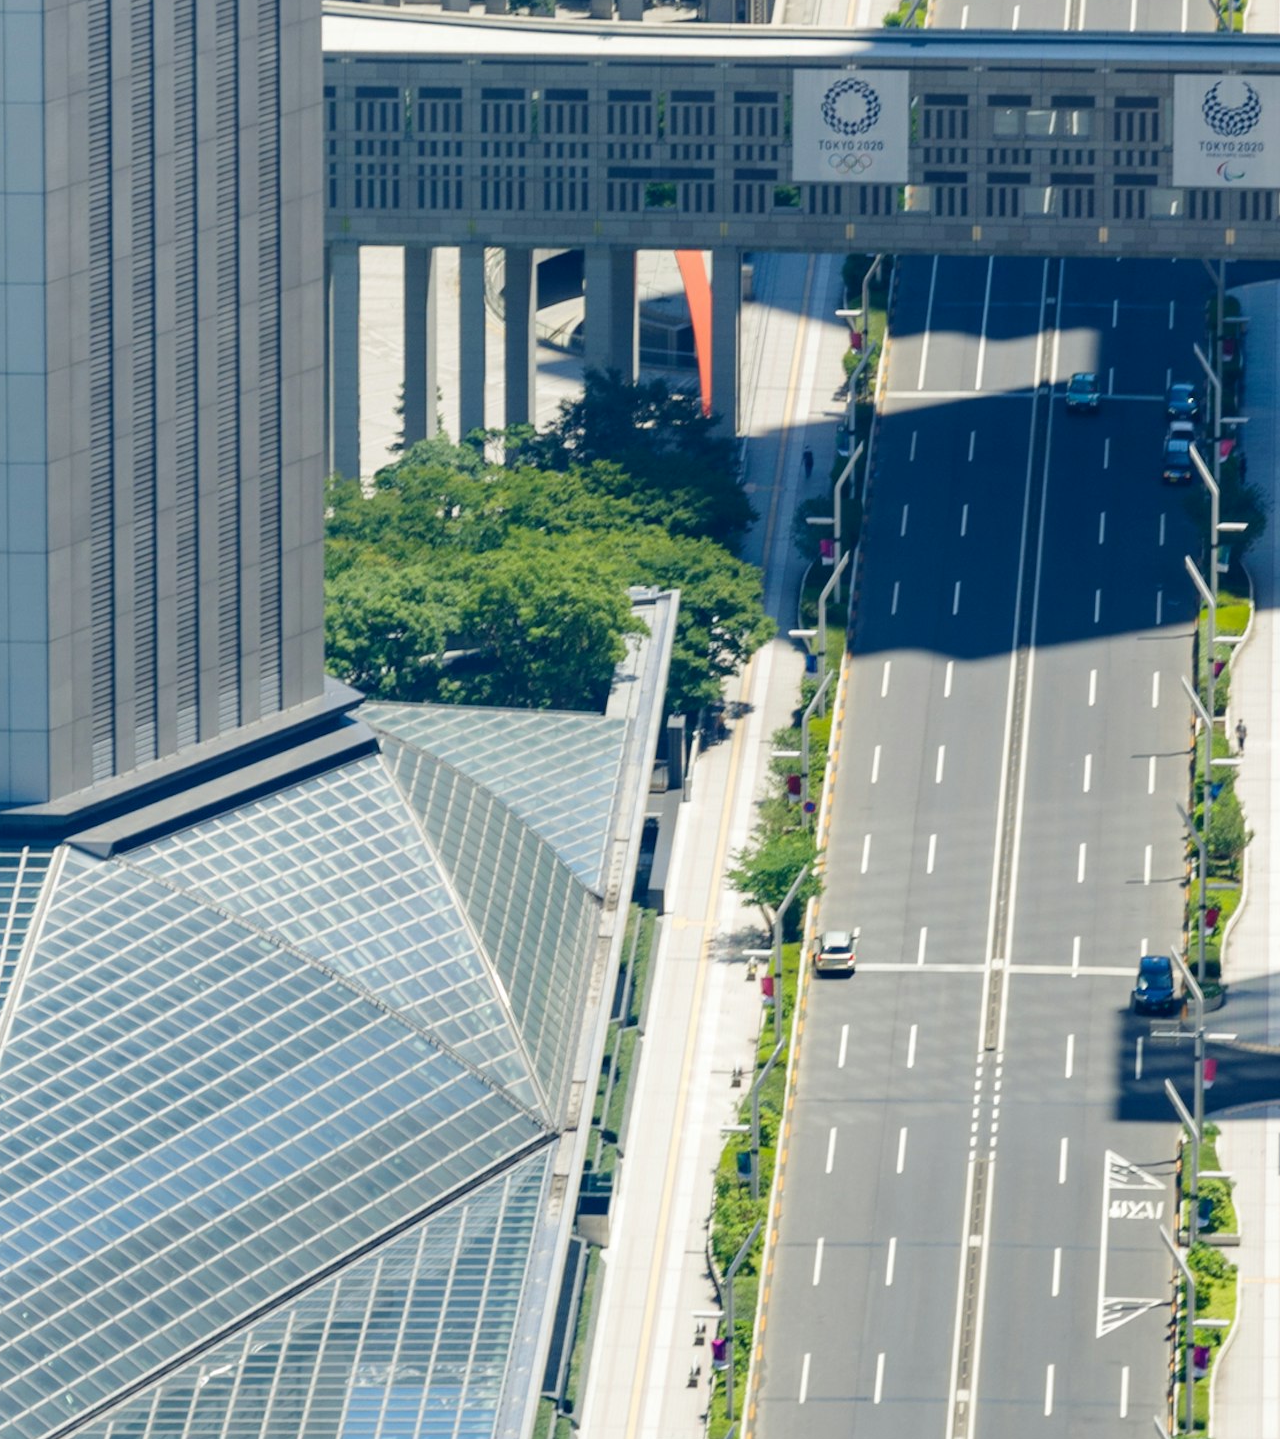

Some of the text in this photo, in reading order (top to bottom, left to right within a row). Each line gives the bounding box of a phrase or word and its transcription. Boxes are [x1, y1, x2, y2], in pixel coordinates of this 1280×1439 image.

[819, 140, 884, 151] TOKYO 2020
[1199, 141, 1264, 153] TOKYO 2020
